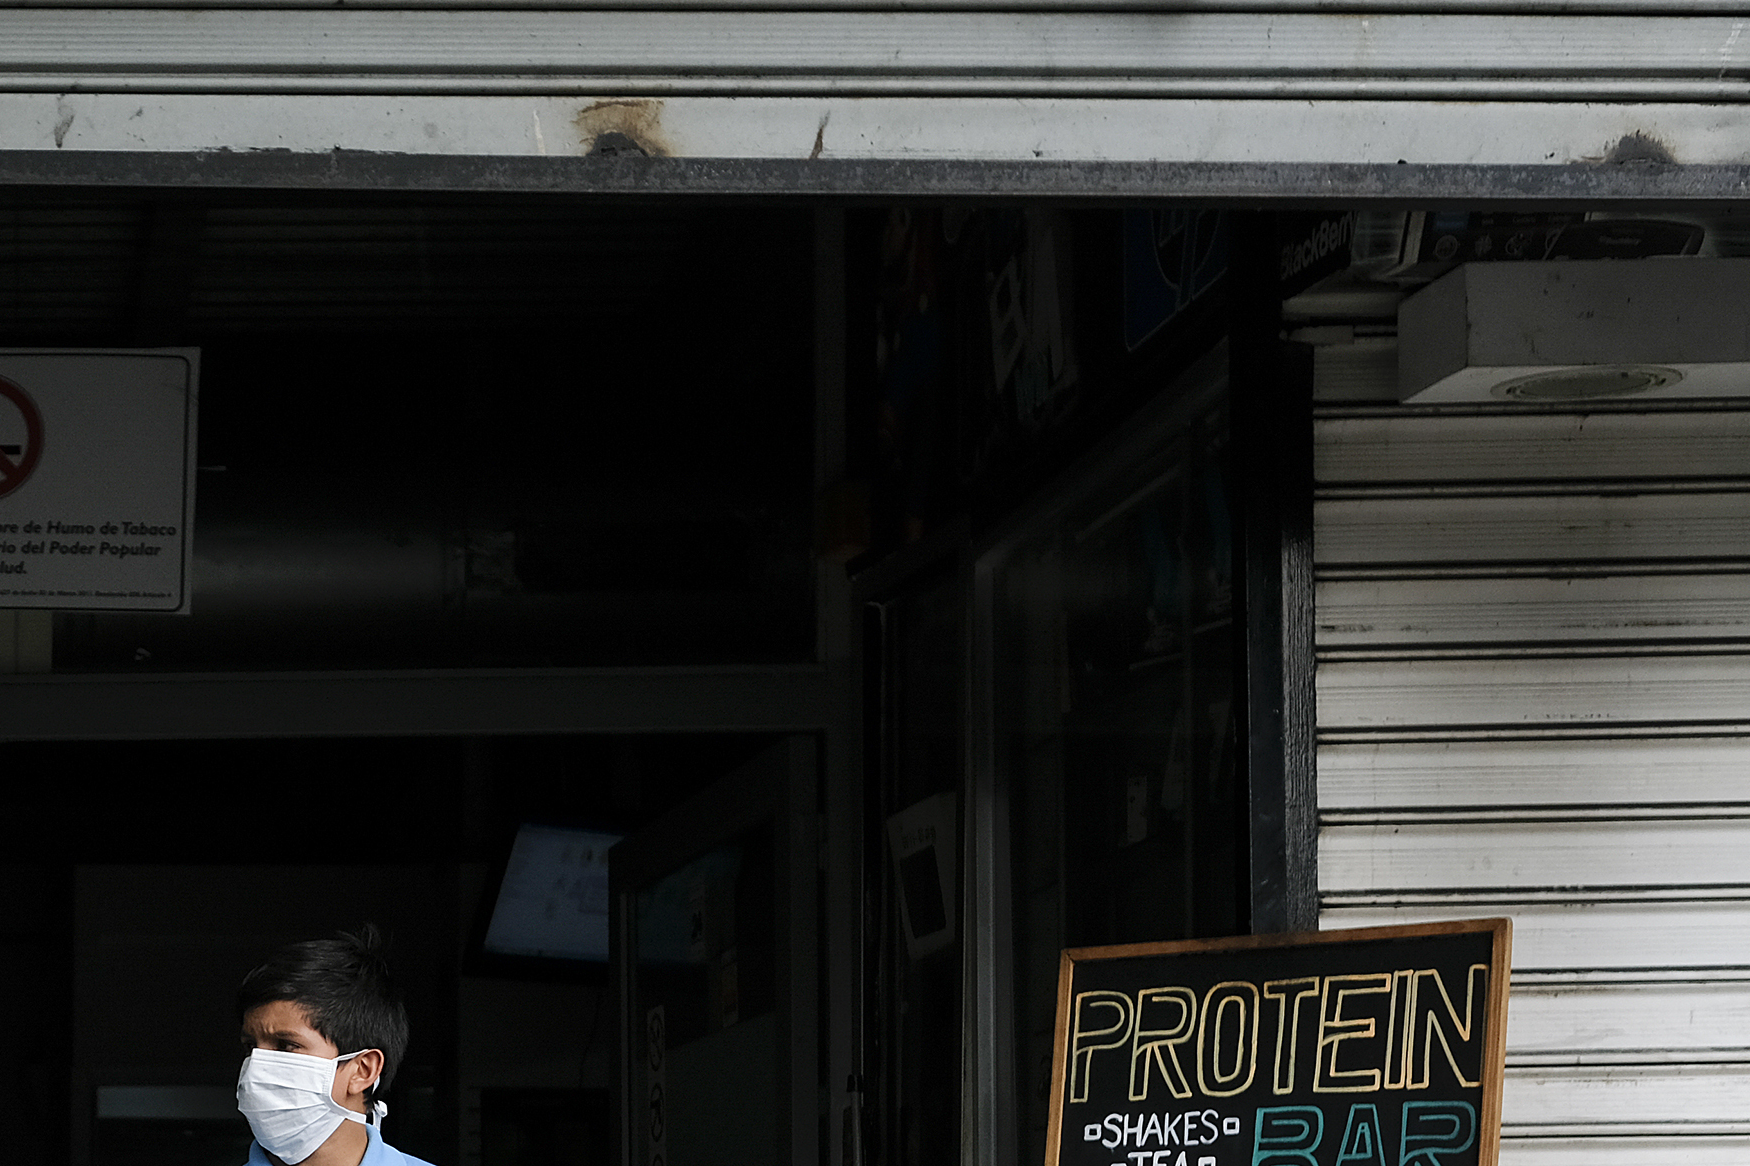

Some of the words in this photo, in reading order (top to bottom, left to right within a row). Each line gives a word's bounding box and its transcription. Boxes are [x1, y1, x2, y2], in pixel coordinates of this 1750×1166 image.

[23, 520, 43, 535] de
[47, 521, 95, 535] Humo
[99, 522, 119, 536] de
[122, 521, 178, 536] Tabaco
[20, 541, 45, 555] del
[48, 541, 96, 555] Poder
[99, 541, 162, 559] Popular
[1069, 963, 1489, 1103] PROTEIN
[1101, 1109, 1221, 1148] SHAKES
